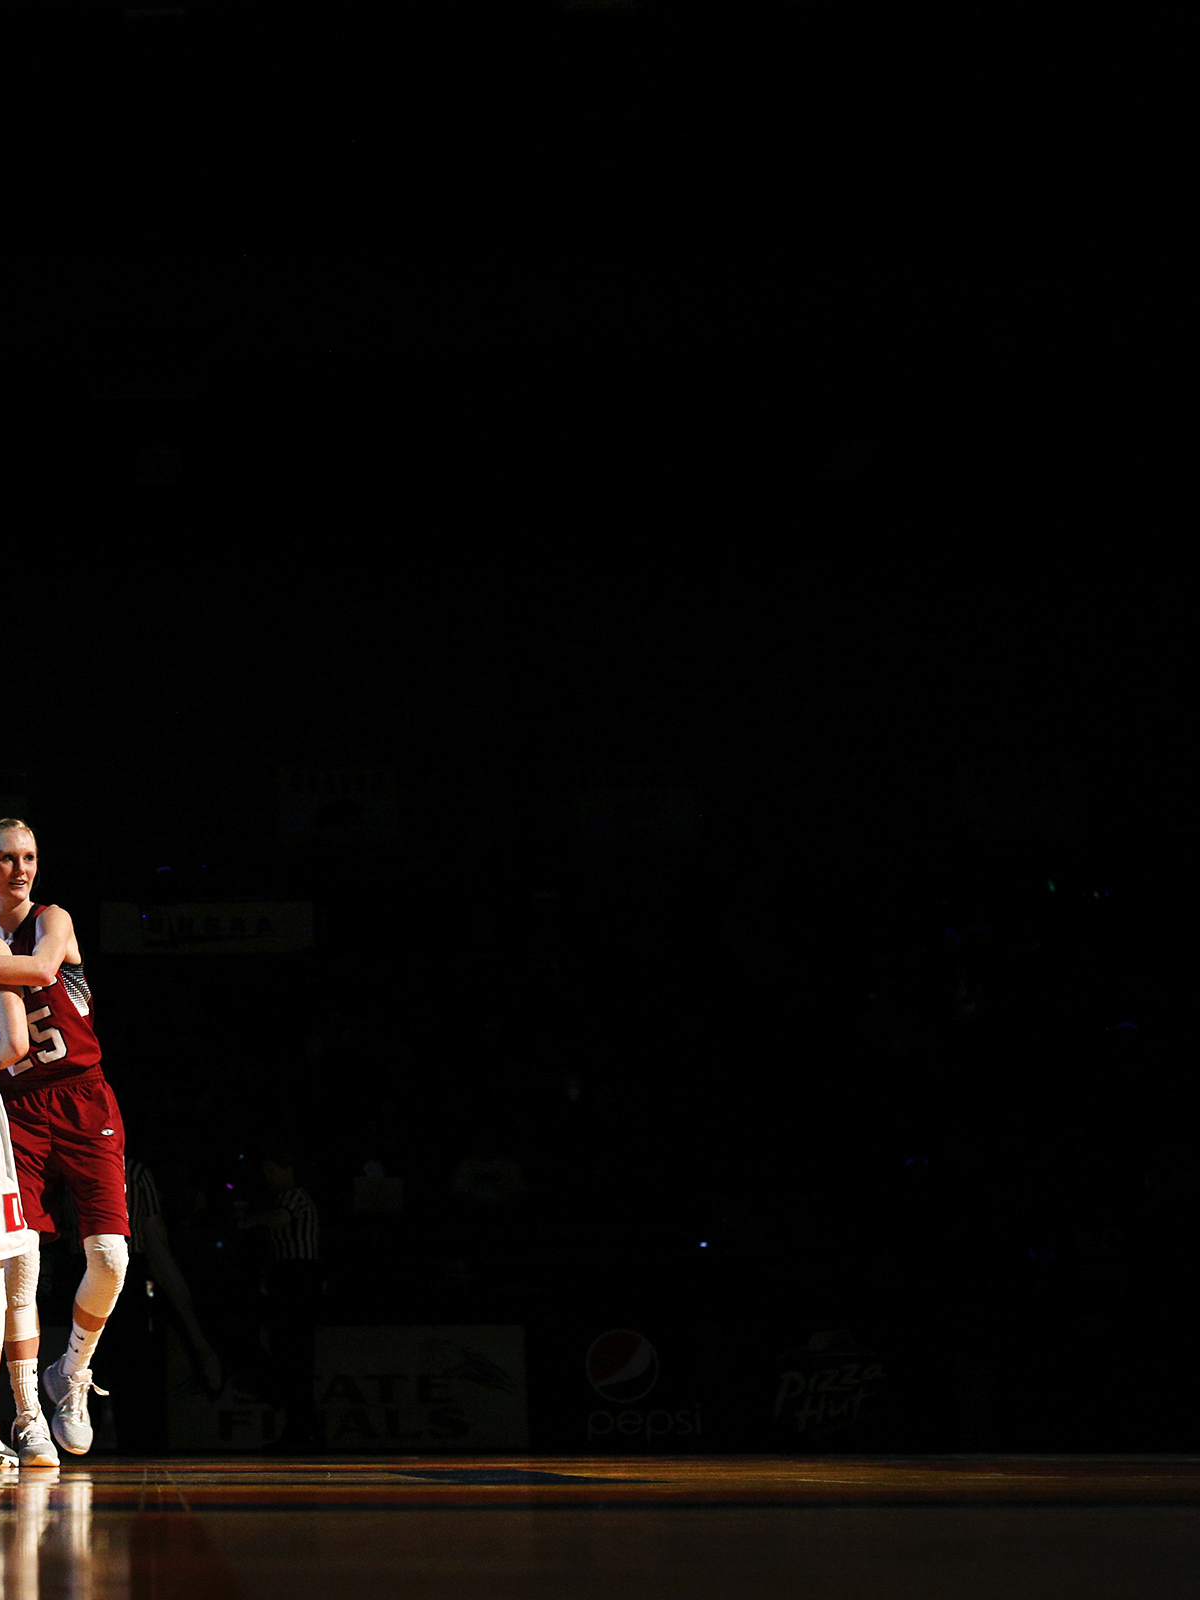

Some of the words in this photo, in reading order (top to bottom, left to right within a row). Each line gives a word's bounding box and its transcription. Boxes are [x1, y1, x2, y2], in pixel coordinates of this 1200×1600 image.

[773, 1361, 887, 1419] Pizza
[793, 1386, 876, 1433] Hut
[218, 1406, 470, 1441] FIALS
[587, 1402, 703, 1443] pepsi
